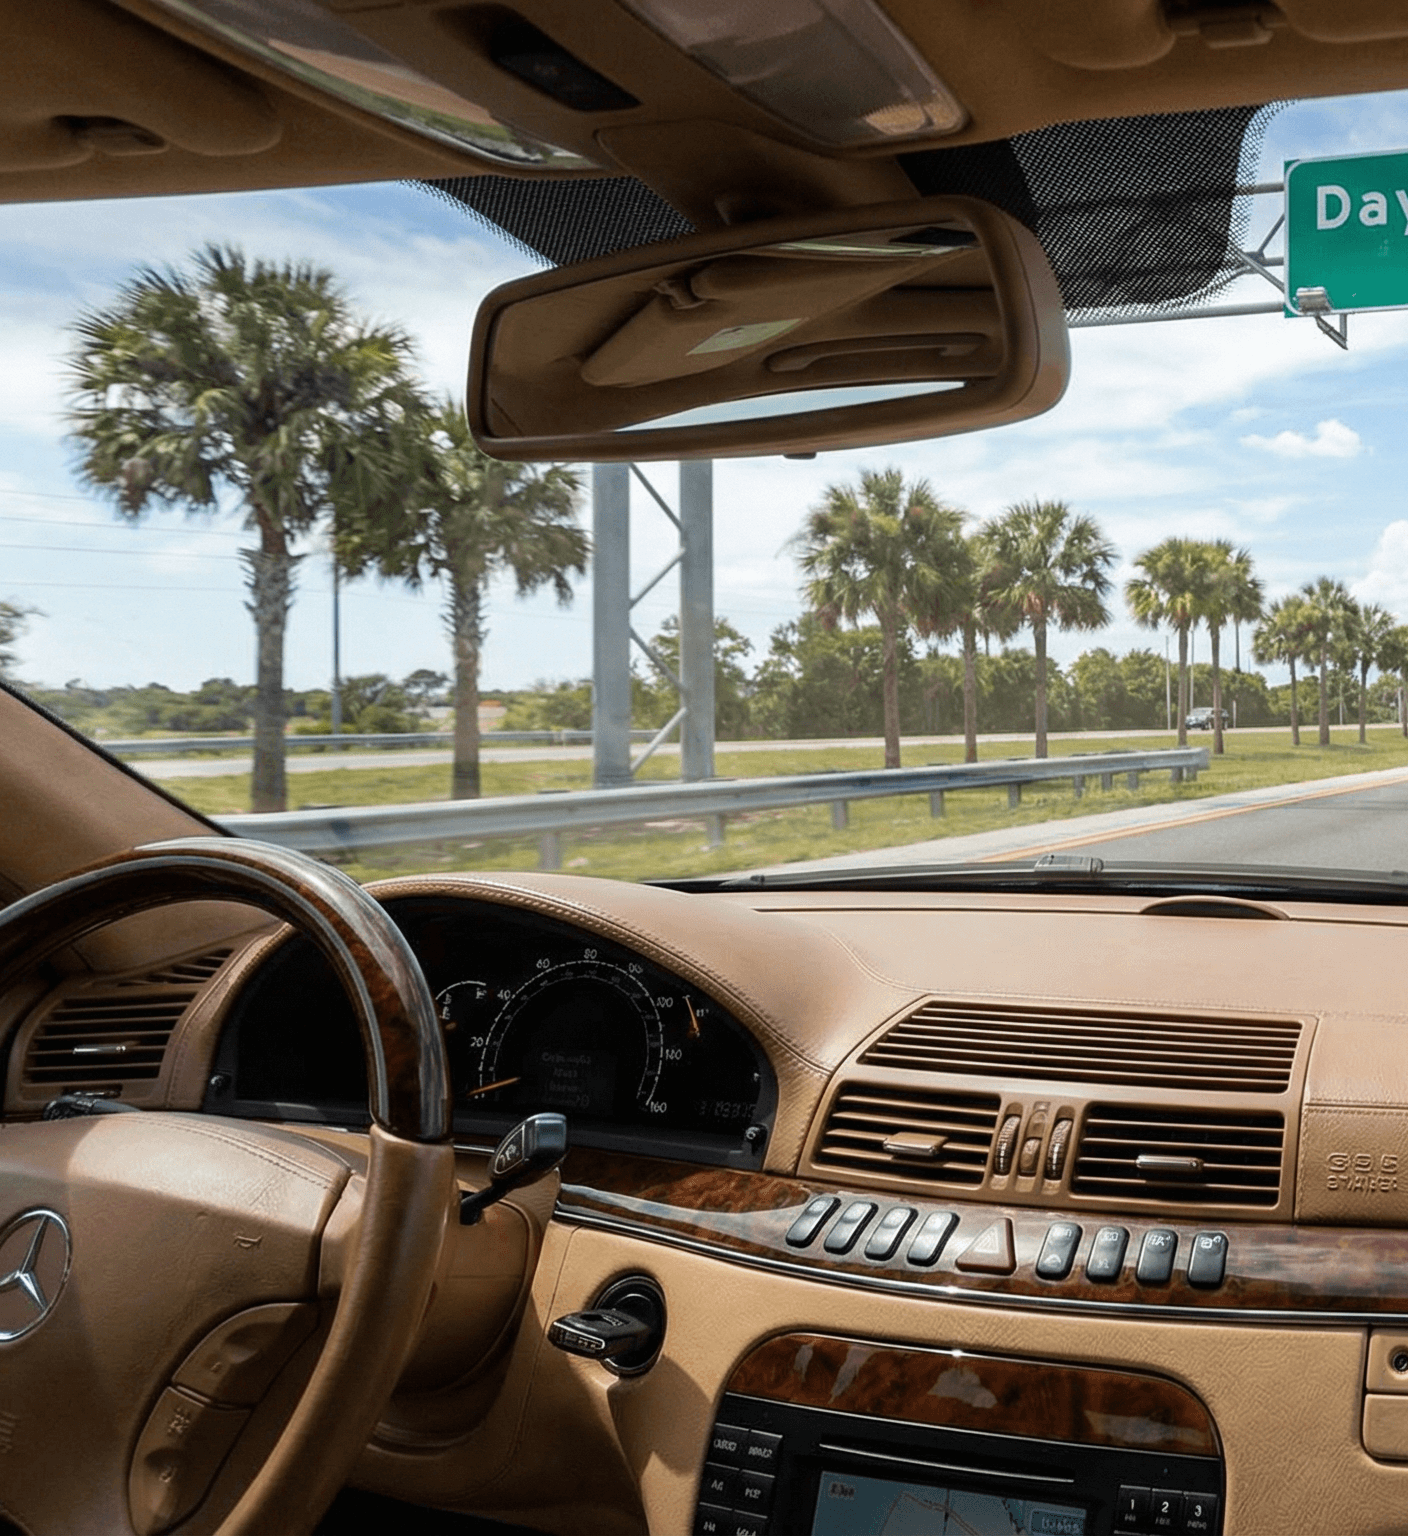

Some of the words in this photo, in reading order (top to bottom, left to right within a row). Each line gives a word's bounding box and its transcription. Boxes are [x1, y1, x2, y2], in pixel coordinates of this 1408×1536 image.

[470, 1036, 484, 1048] 20
[1161, 1501, 1170, 1513] 2
[1194, 1504, 1202, 1517] 3
